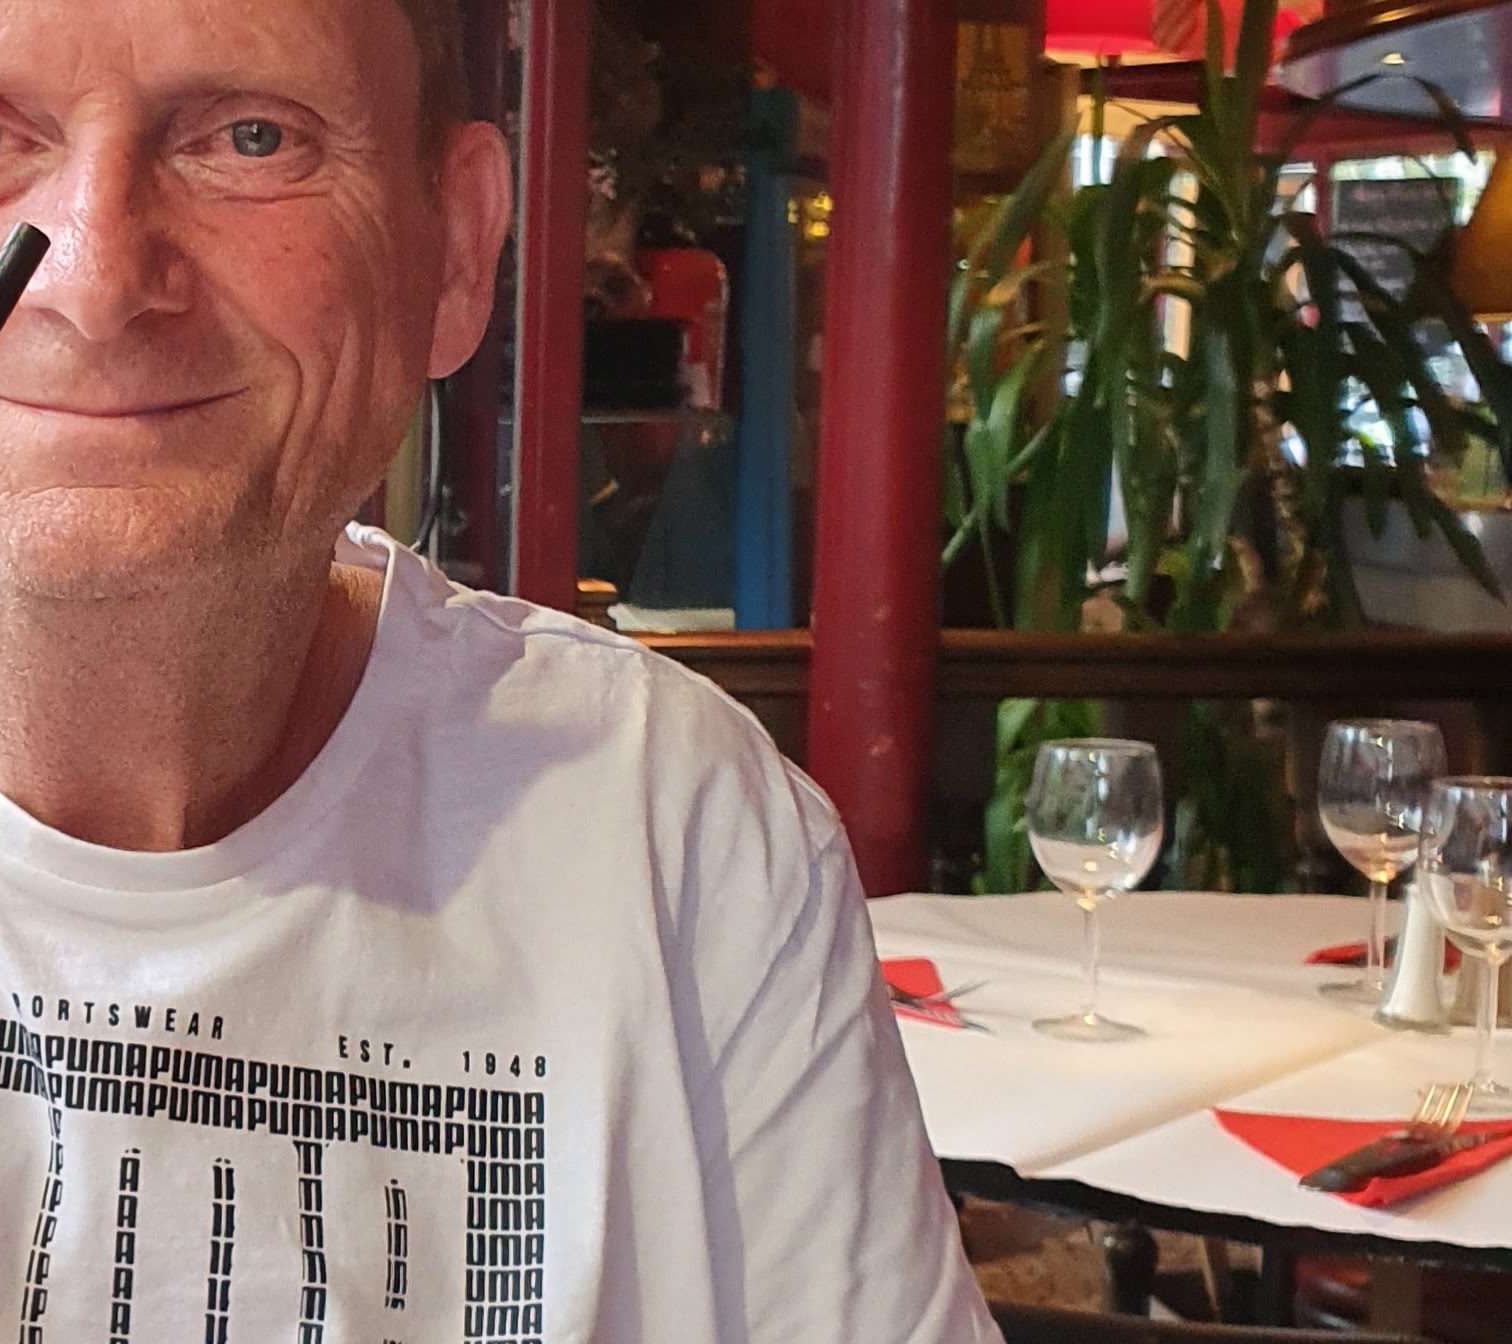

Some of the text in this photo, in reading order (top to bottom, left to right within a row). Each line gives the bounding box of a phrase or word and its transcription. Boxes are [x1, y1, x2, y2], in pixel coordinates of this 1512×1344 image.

[12, 992, 225, 1041] ORTSWEAR
[338, 1034, 411, 1069] EST.
[462, 1049, 547, 1078] 1948
